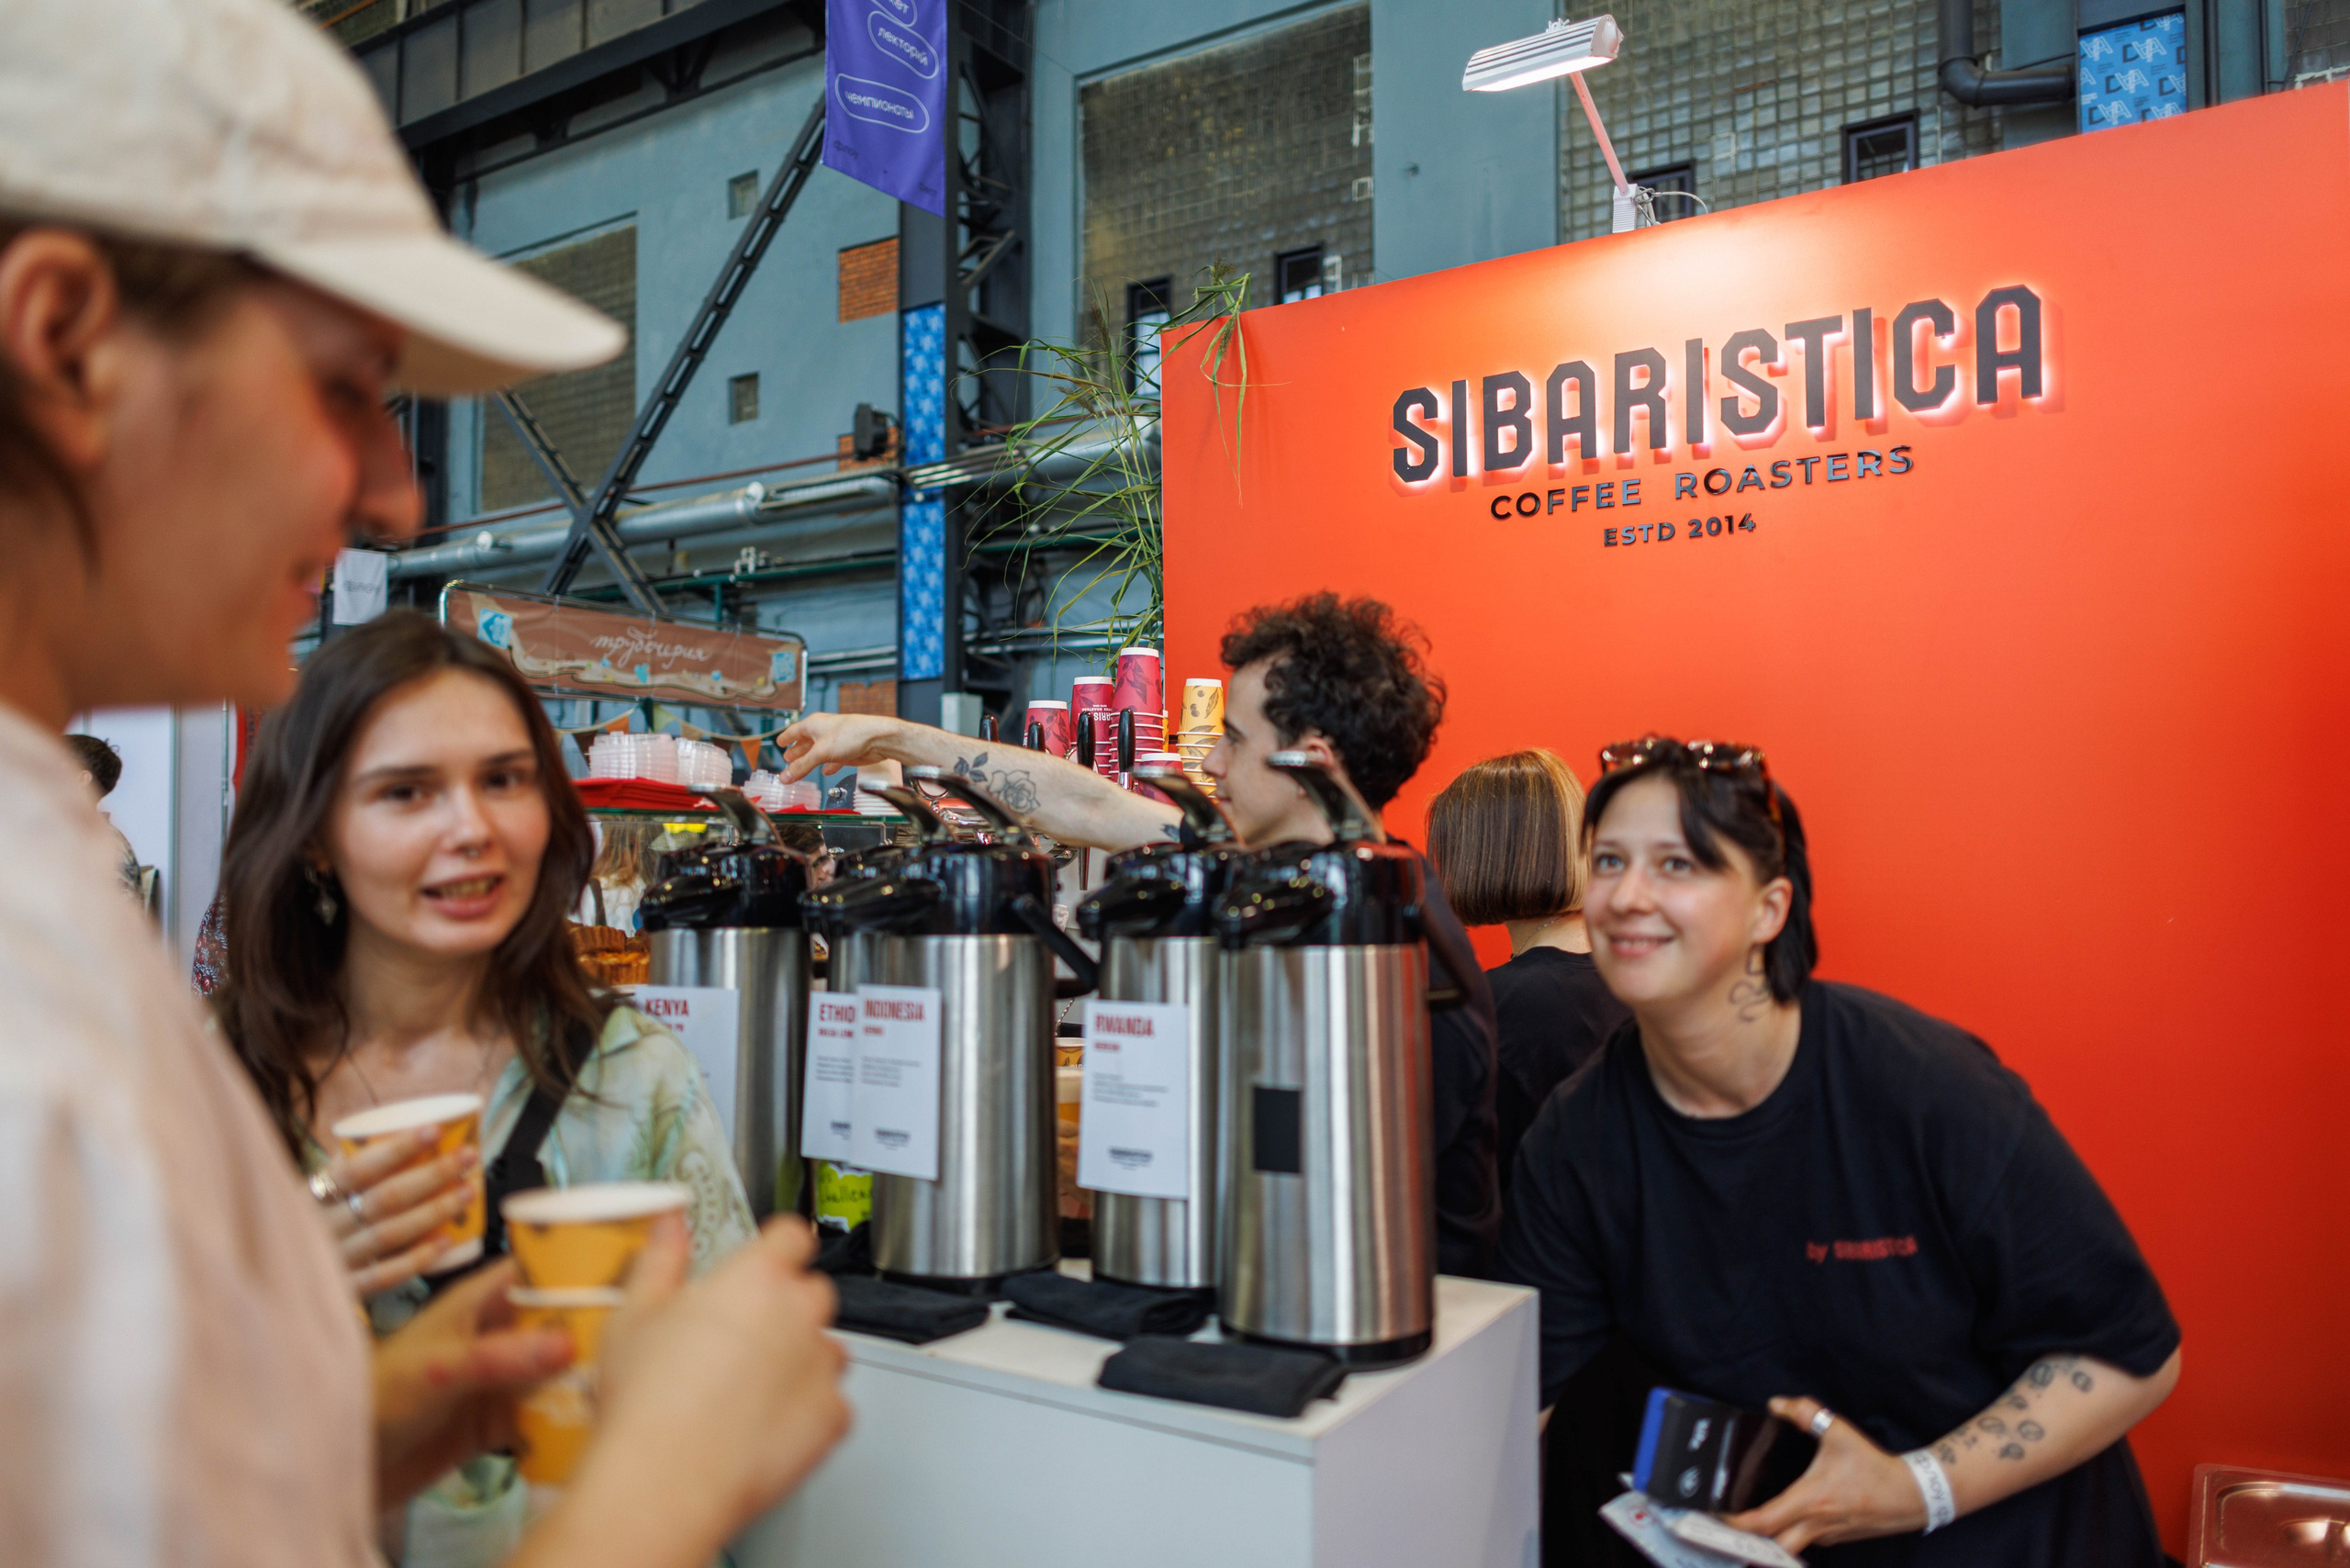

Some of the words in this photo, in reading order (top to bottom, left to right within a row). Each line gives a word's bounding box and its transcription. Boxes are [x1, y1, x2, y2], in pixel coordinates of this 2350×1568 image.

[878, 27, 928, 67] лекторий
[844, 90, 914, 120] чемпионаты
[1393, 284, 2042, 483] SIBARISTICA
[1490, 478, 1641, 521] COFFEE
[1674, 445, 1913, 500] ROASTERS
[1604, 521, 1675, 547] ESTD
[1688, 512, 1755, 538] 2014
[644, 998, 689, 1016] KENYA
[865, 998, 924, 1022] INDONESIA
[1095, 1013, 1154, 1036] RWANDA
